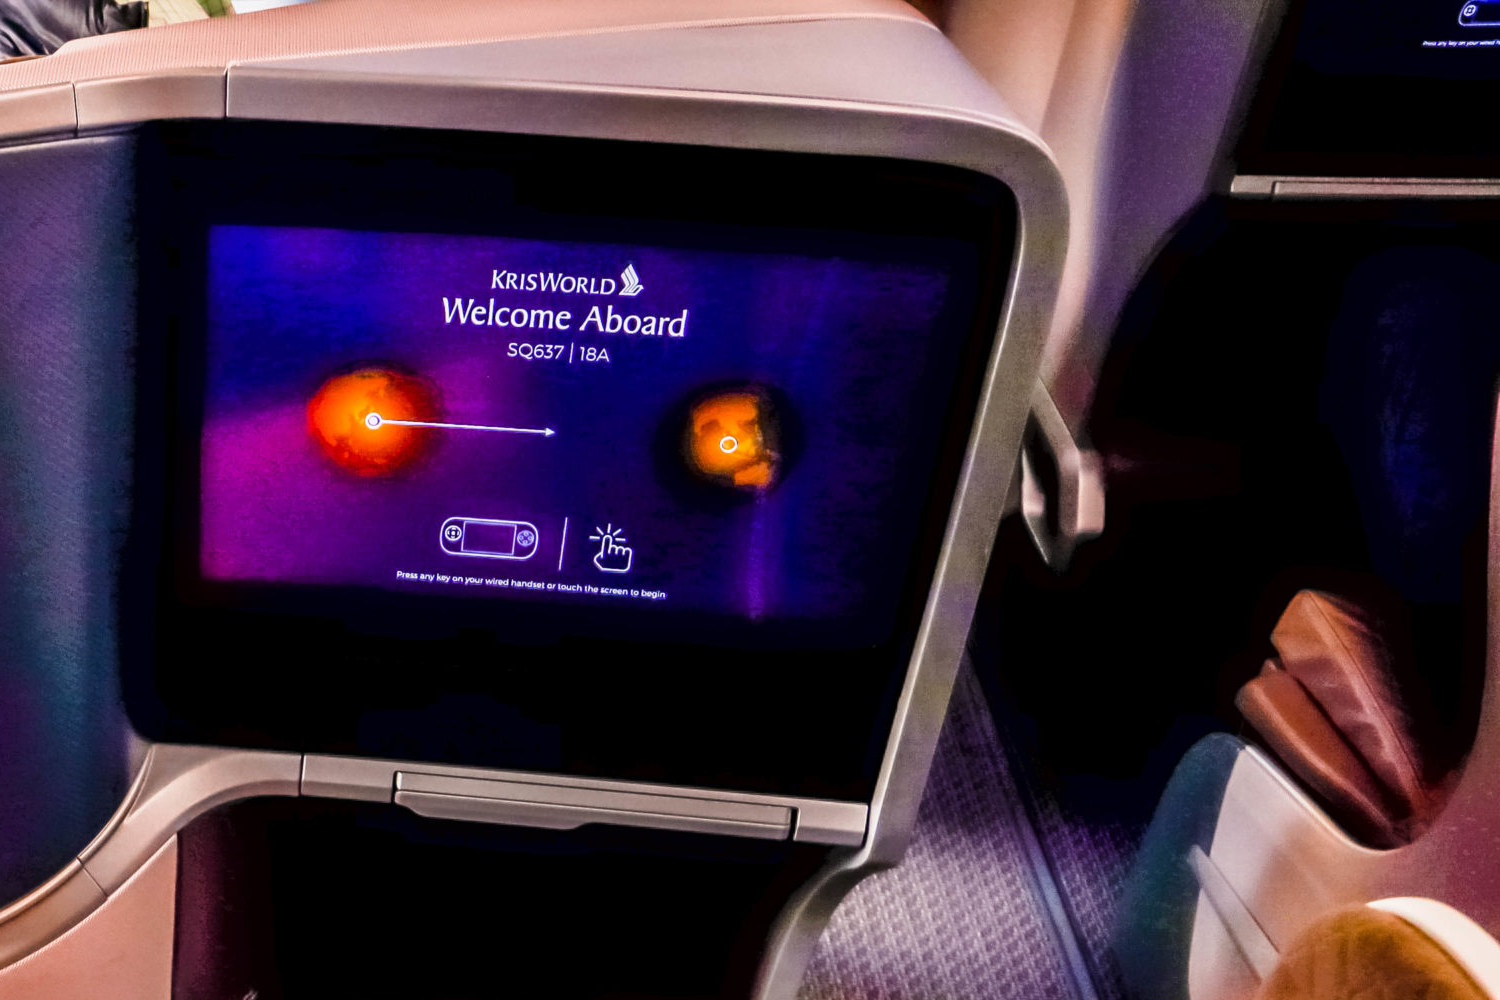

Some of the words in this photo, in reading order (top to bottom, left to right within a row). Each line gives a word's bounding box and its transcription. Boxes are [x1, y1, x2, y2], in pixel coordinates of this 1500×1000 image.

[491, 269, 616, 296] KRISWORLD
[442, 297, 571, 330] Welcome
[579, 305, 688, 337] Aboard
[507, 342, 564, 360] SQ637
[579, 346, 610, 362] 18A
[396, 570, 418, 579] Press
[420, 573, 435, 583] any
[436, 573, 451, 583] key
[465, 577, 484, 586] your
[485, 578, 509, 587] wired
[511, 579, 545, 590] handset
[558, 583, 582, 592] touch
[584, 584, 598, 593] the
[600, 587, 628, 595] screen
[641, 589, 666, 599] begin
